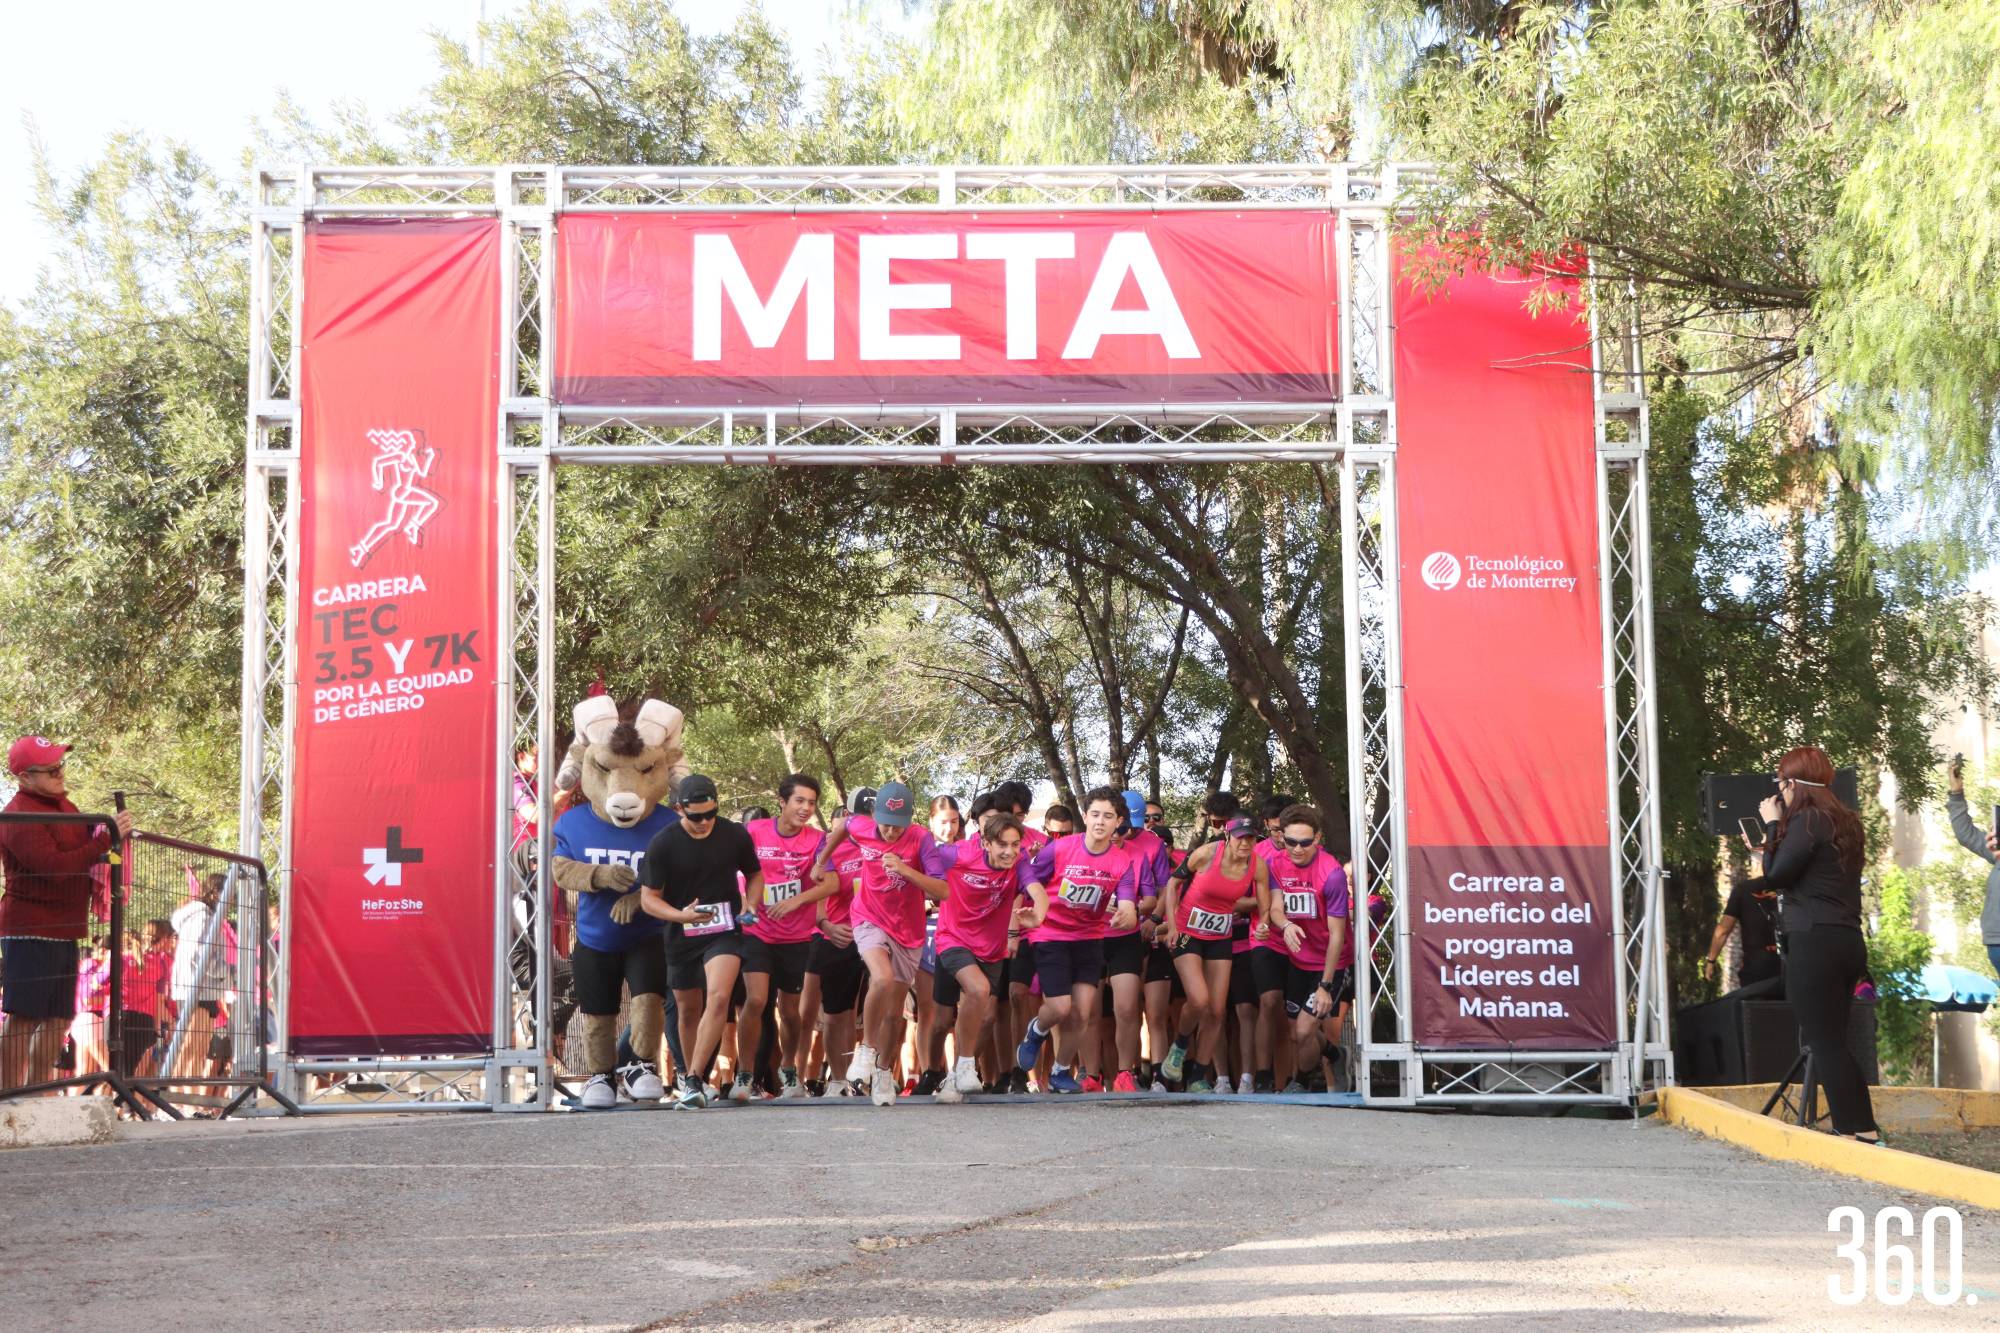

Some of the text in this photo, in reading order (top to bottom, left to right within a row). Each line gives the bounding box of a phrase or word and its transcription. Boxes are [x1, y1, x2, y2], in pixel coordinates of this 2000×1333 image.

[693, 231, 1202, 361] META
[1465, 555, 1564, 574] Tecnológico
[313, 575, 427, 606] CARRERA
[1466, 574, 1577, 592] de Monterrey
[314, 603, 399, 645] TEC
[315, 630, 481, 684] 3.5 Y 7K
[314, 668, 474, 704] POR LA EQUIDAD
[314, 694, 424, 723] DE GÉNERO
[1448, 872, 1565, 892] Carrera a
[771, 883, 797, 903] 175
[1067, 885, 1095, 902] 277
[362, 899, 423, 910] HeForShe
[1424, 902, 1591, 923] beneficio del
[1198, 912, 1225, 931] 762
[1445, 938, 1574, 959] programa
[1440, 965, 1580, 986] Líderes del
[1459, 996, 1569, 1017] Mañana.
